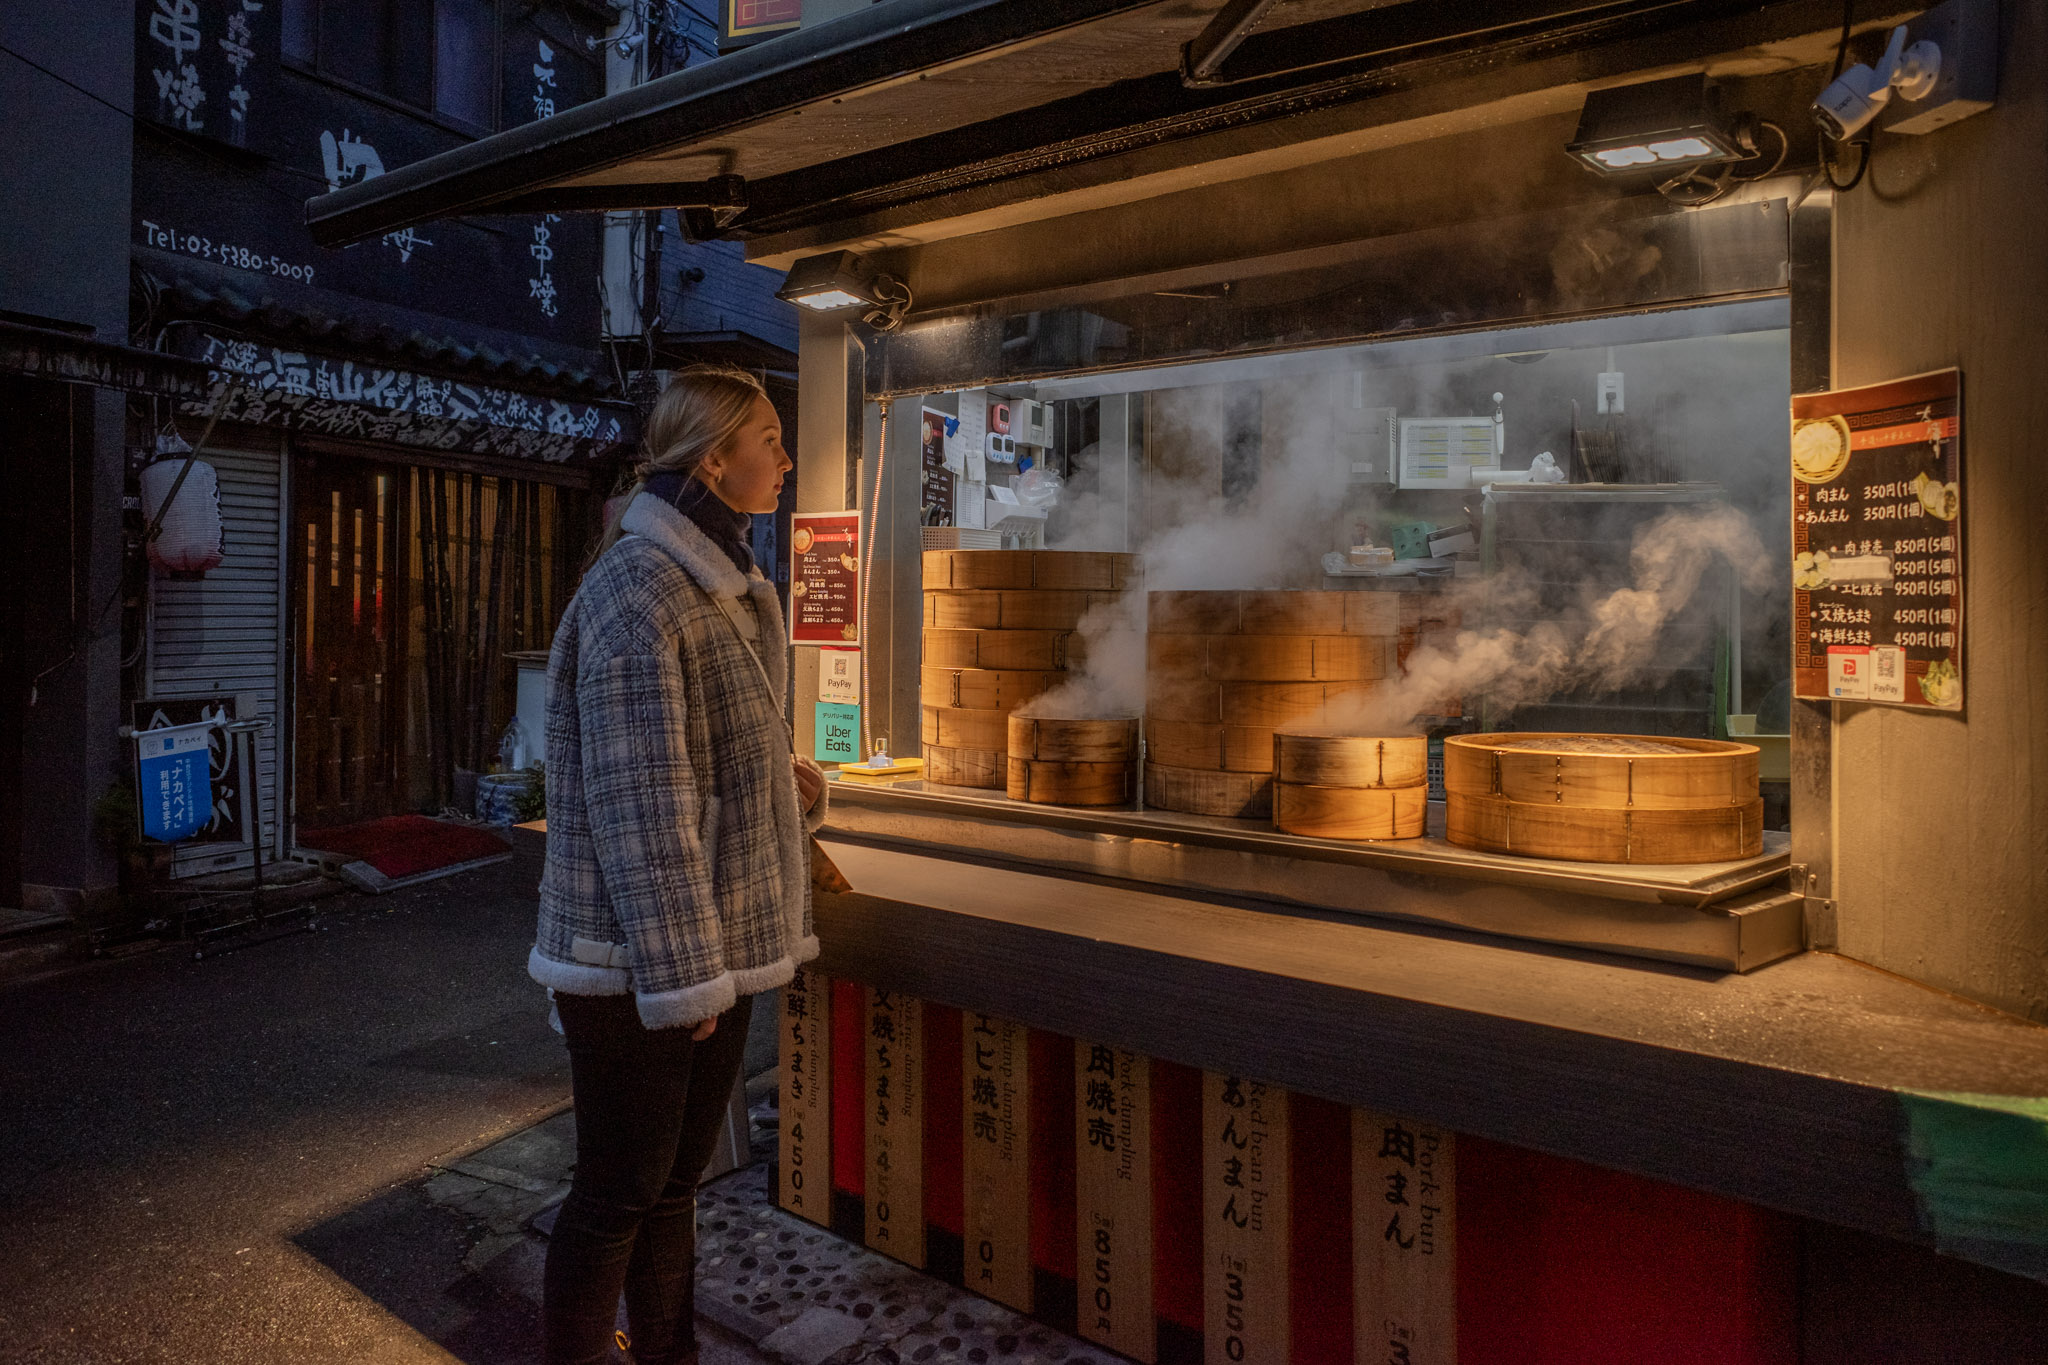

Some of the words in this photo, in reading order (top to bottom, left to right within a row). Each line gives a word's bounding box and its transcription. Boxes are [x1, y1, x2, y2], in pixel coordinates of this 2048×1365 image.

[1805, 509, 1850, 524] あんまん
[1863, 501, 1925, 521] 350円(1個)
[1816, 487, 1850, 504] 肉まん
[1894, 536, 1955, 554] 850円(5個)
[1894, 558, 1956, 576] 950円(5個)
[1894, 579, 1956, 597] 950円(5個)
[1893, 607, 1956, 625] 450円(1個)
[1819, 628, 1872, 645] 海鮮ちまき
[1893, 630, 1956, 649] 450円(1個)
[827, 679, 852, 690] PayPay
[1874, 683, 1898, 695] PayPay
[825, 738, 852, 753] Eats
[826, 724, 852, 738] Uber
[160, 769, 172, 831] 利用できます
[172, 759, 185, 829] 「ナカペイ」
[807, 1050, 820, 1108] dumpling
[901, 1055, 915, 1118] dumpling
[1120, 1050, 1136, 1091] Pork
[999, 1082, 1017, 1161] dumpling
[1250, 1081, 1268, 1126] Red
[1116, 1096, 1137, 1182] dumpling
[1250, 1131, 1268, 1184] bean
[1420, 1130, 1441, 1196] Pork
[1378, 1122, 1416, 1251] 肉まん
[1250, 1190, 1268, 1232] bun
[1420, 1205, 1441, 1256] bun
